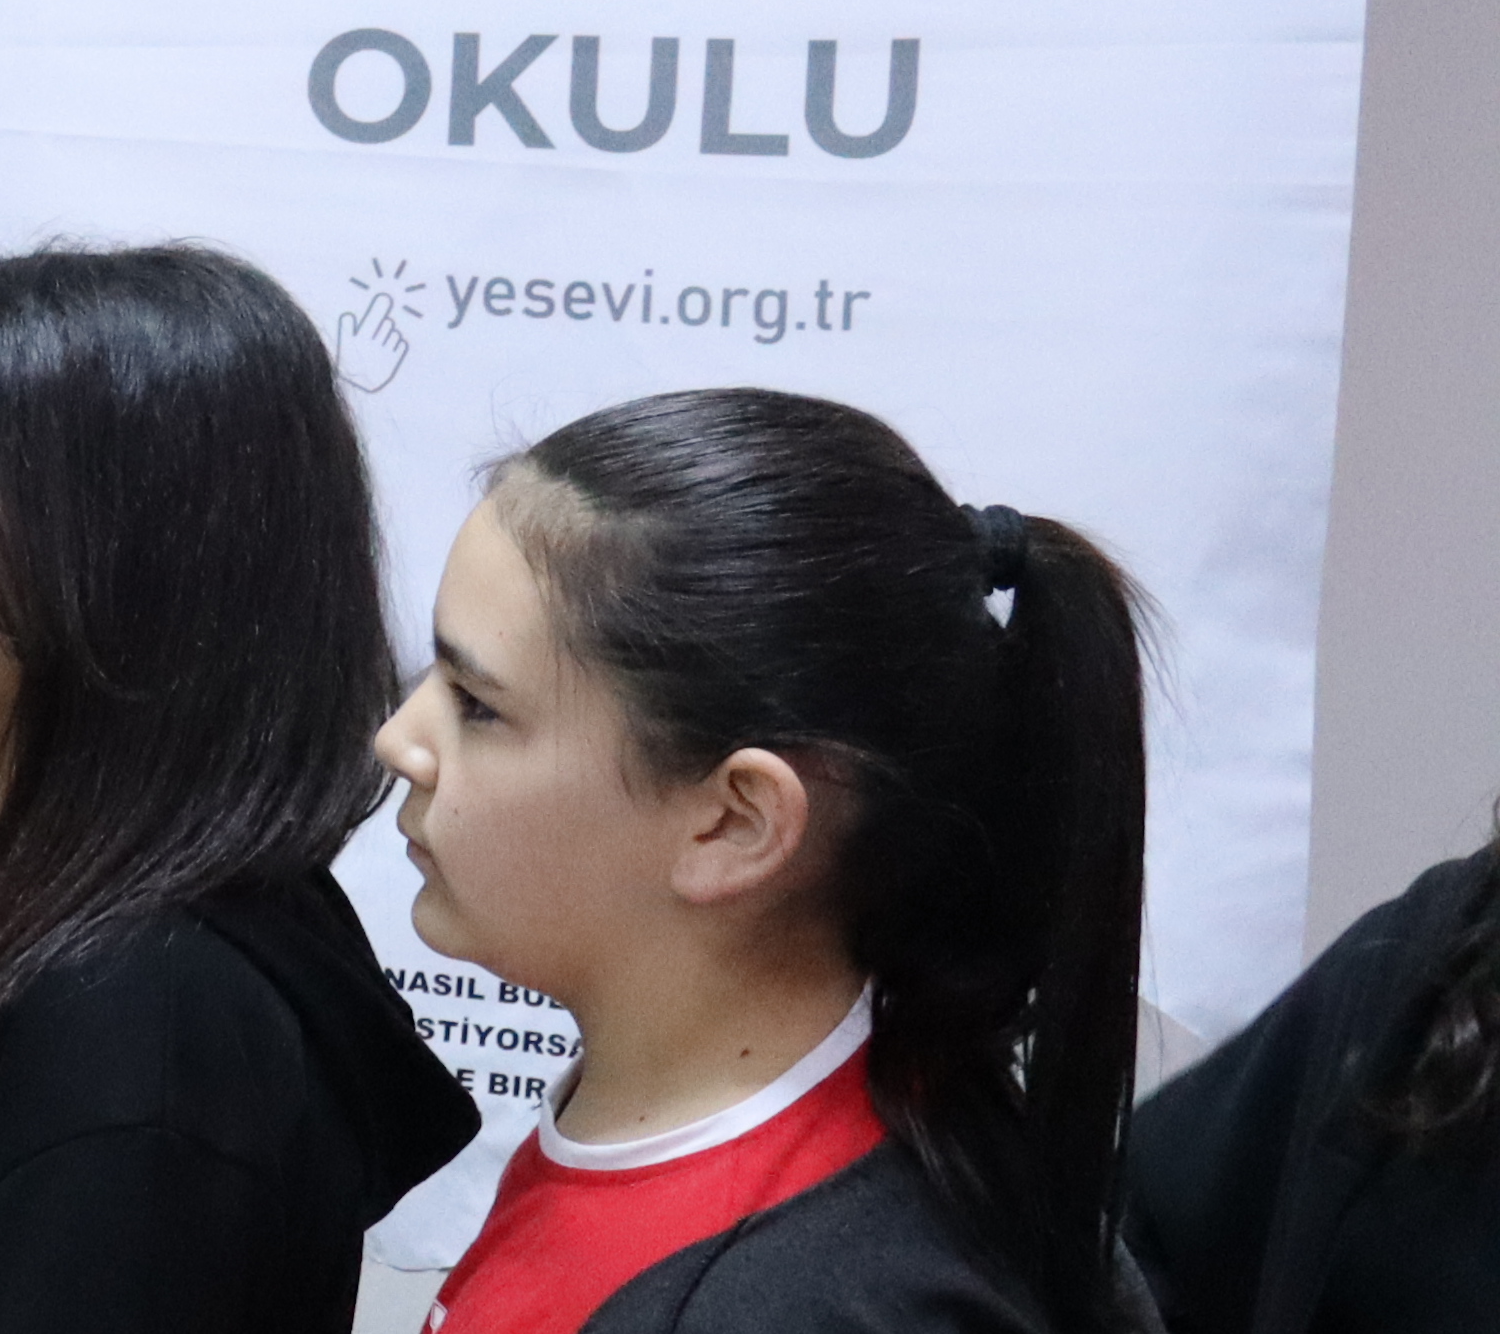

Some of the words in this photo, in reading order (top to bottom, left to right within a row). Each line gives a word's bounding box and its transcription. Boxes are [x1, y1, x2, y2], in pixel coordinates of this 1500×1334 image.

[306, 26, 921, 159] OKULU
[445, 267, 872, 345] yesevi.org.tr
[384, 967, 485, 1000] NASIL
[416, 1017, 582, 1059] STİYORS
